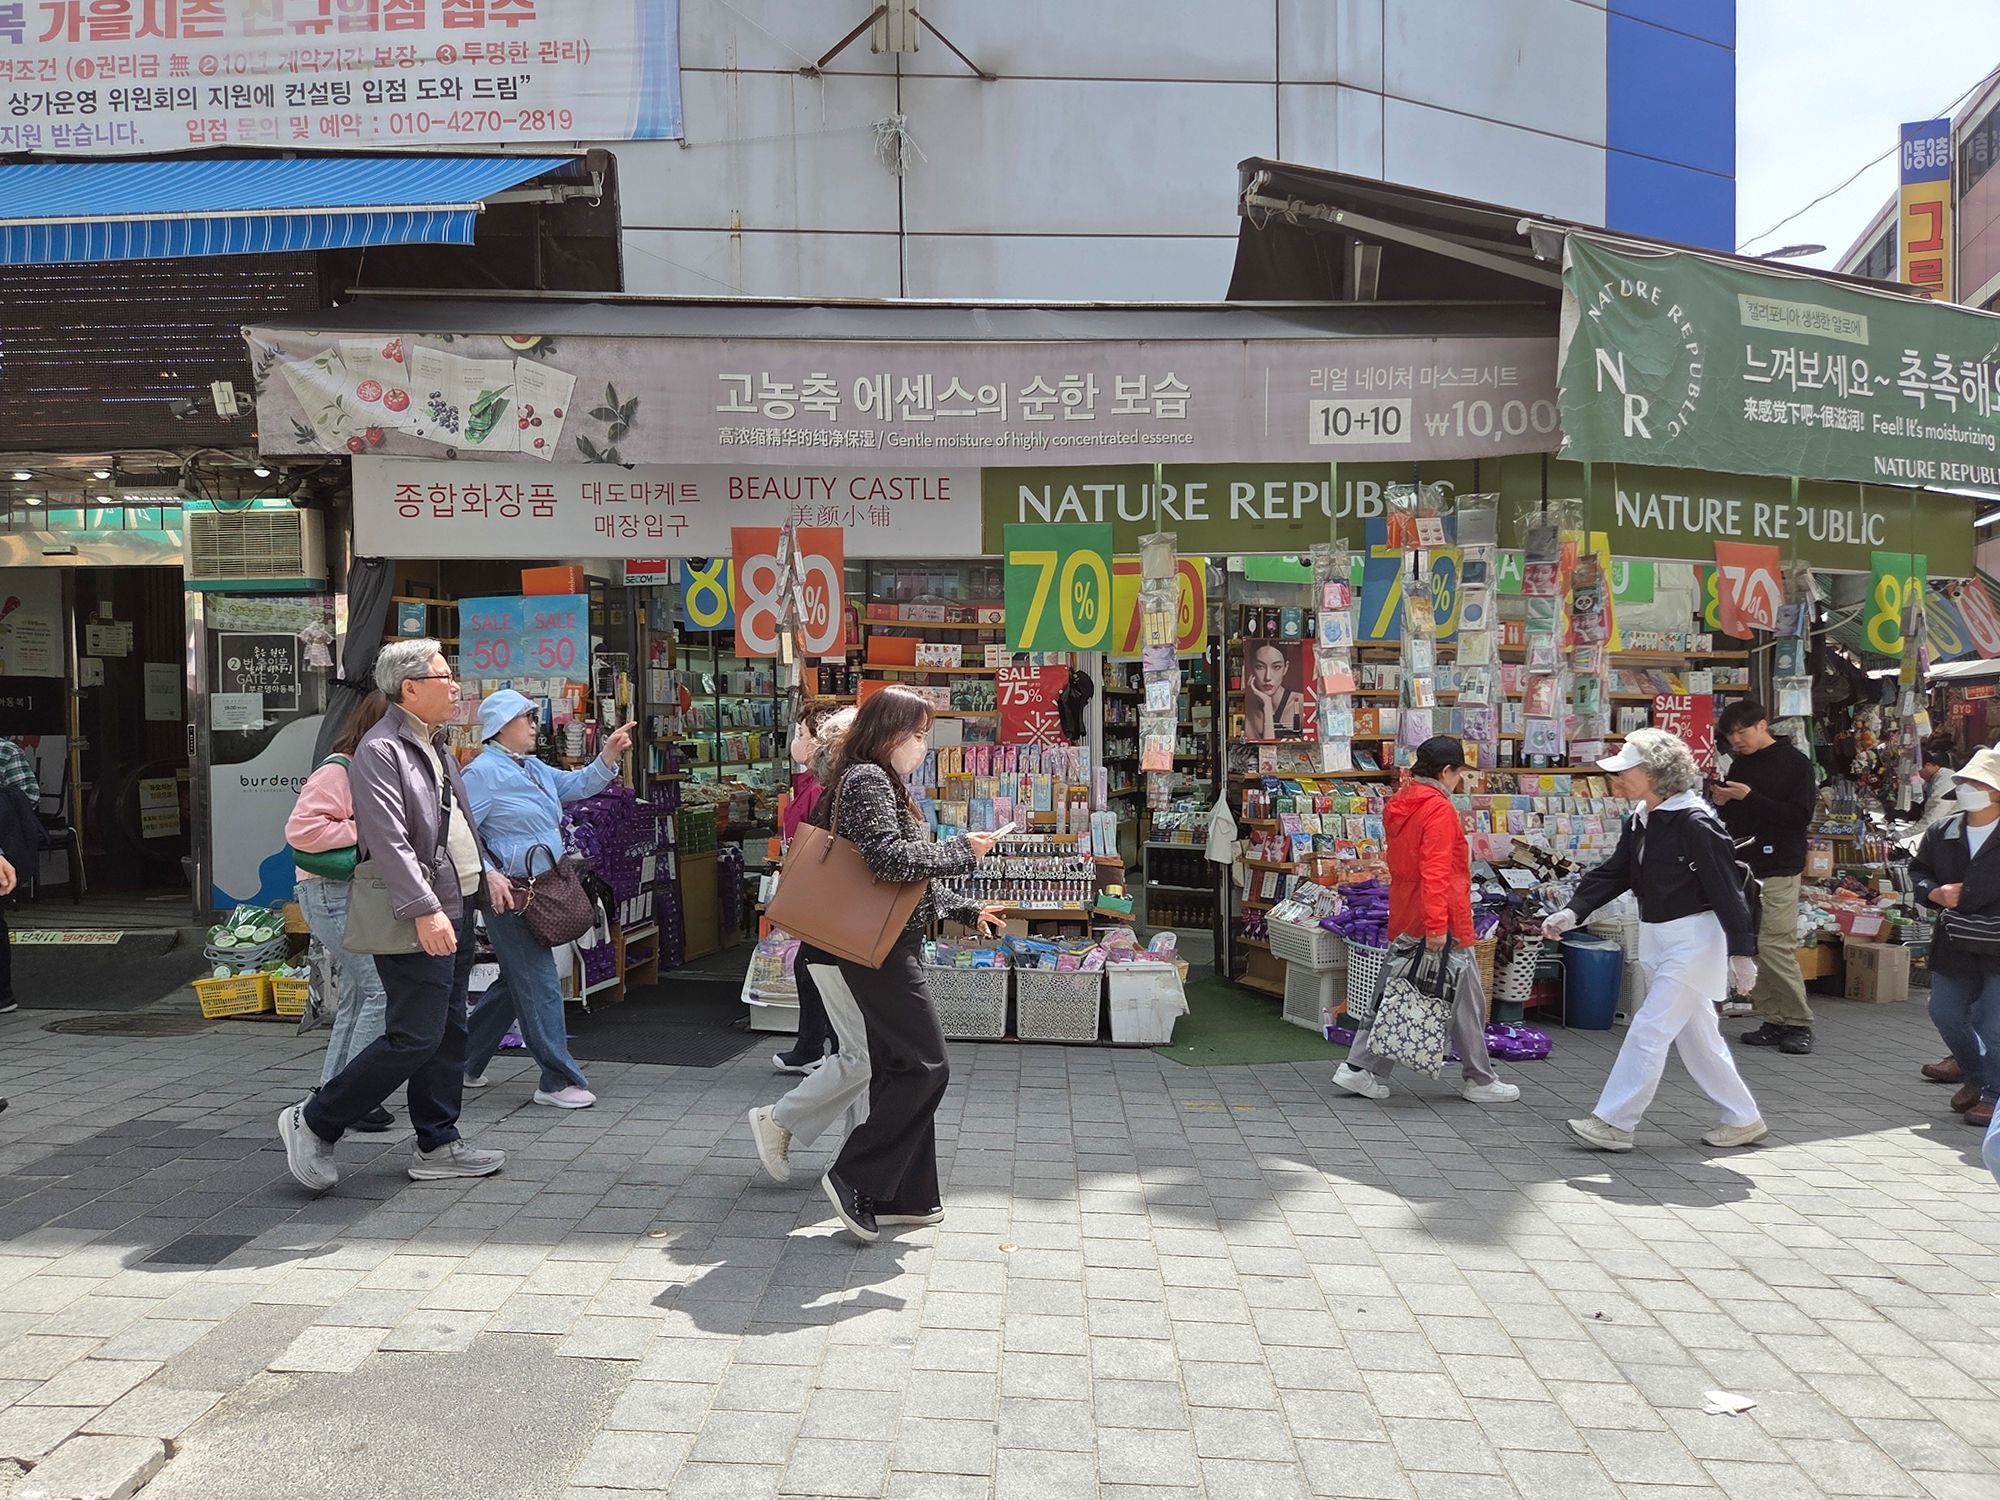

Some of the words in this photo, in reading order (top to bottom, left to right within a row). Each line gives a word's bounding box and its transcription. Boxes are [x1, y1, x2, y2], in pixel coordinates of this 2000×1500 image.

[39, 0, 228, 43] 가을시즌
[169, 53, 190, 78] 無
[538, 38, 591, 65] 관리)
[8, 90, 97, 117] 상가운영
[108, 86, 197, 113] 위원회의
[208, 83, 275, 109] 지원에
[285, 80, 351, 107] 컨설팅
[362, 78, 407, 104] 입점
[416, 76, 463, 102] 도와
[0, 123, 43, 149] 지원
[51, 120, 145, 149] 받습니다.
[186, 117, 228, 144] 입점
[289, 115, 309, 140] 및
[319, 112, 363, 139] 예약
[389, 109, 574, 135] 010-4270-2819
[1903, 136, 1948, 171] C동3층
[1586, 278, 1664, 326] NATURE
[1801, 311, 1832, 333] 생생한
[1832, 315, 1862, 338] 알로에
[1308, 366, 1349, 391] 리얼
[1355, 365, 1413, 391] 네이처
[1420, 366, 1519, 389] 마스크시트
[1667, 303, 1704, 439] REPUBLIC
[1743, 344, 1891, 399] 느껴보세요~
[716, 371, 842, 423] 고농축
[853, 373, 1008, 423] 에센스의
[1018, 373, 1101, 423] 순한
[1111, 371, 1192, 421] 보습
[1320, 405, 1402, 437] 10+10
[1424, 399, 1560, 442] ₩10,00
[1872, 414, 1904, 436] Feel!
[1925, 422, 1997, 453] moisturizing
[718, 426, 876, 449] 高浓缩精华的纯净保湿
[886, 431, 934, 448] Gentle
[935, 432, 993, 448] moisture
[995, 431, 1009, 447] of
[1011, 430, 1051, 451] highly
[1052, 429, 1139, 448] concentrated
[1141, 430, 1193, 445] essence
[1874, 456, 1937, 480] NATURE
[1940, 462, 2000, 485] REPUBL
[393, 482, 559, 520] 종합화장품
[581, 481, 701, 505] 대도마케트
[728, 476, 836, 501] BEAUTY
[849, 476, 951, 501] CASTLE
[1018, 482, 1209, 523] NATURE
[594, 513, 690, 539] 매장입구
[791, 504, 891, 528] 美颜小铺
[1617, 489, 1743, 537] NATURE
[1753, 502, 1886, 547] REPUBLIC
[624, 575, 653, 585] SECOM
[1009, 549, 1111, 649] 70%
[471, 612, 513, 633] SALE
[534, 611, 577, 630] SALE
[236, 673, 267, 685] GATE
[272, 673, 280, 685] 2
[998, 666, 1041, 681] SALE
[998, 681, 1043, 706] 75%
[1655, 695, 1692, 711] SALE
